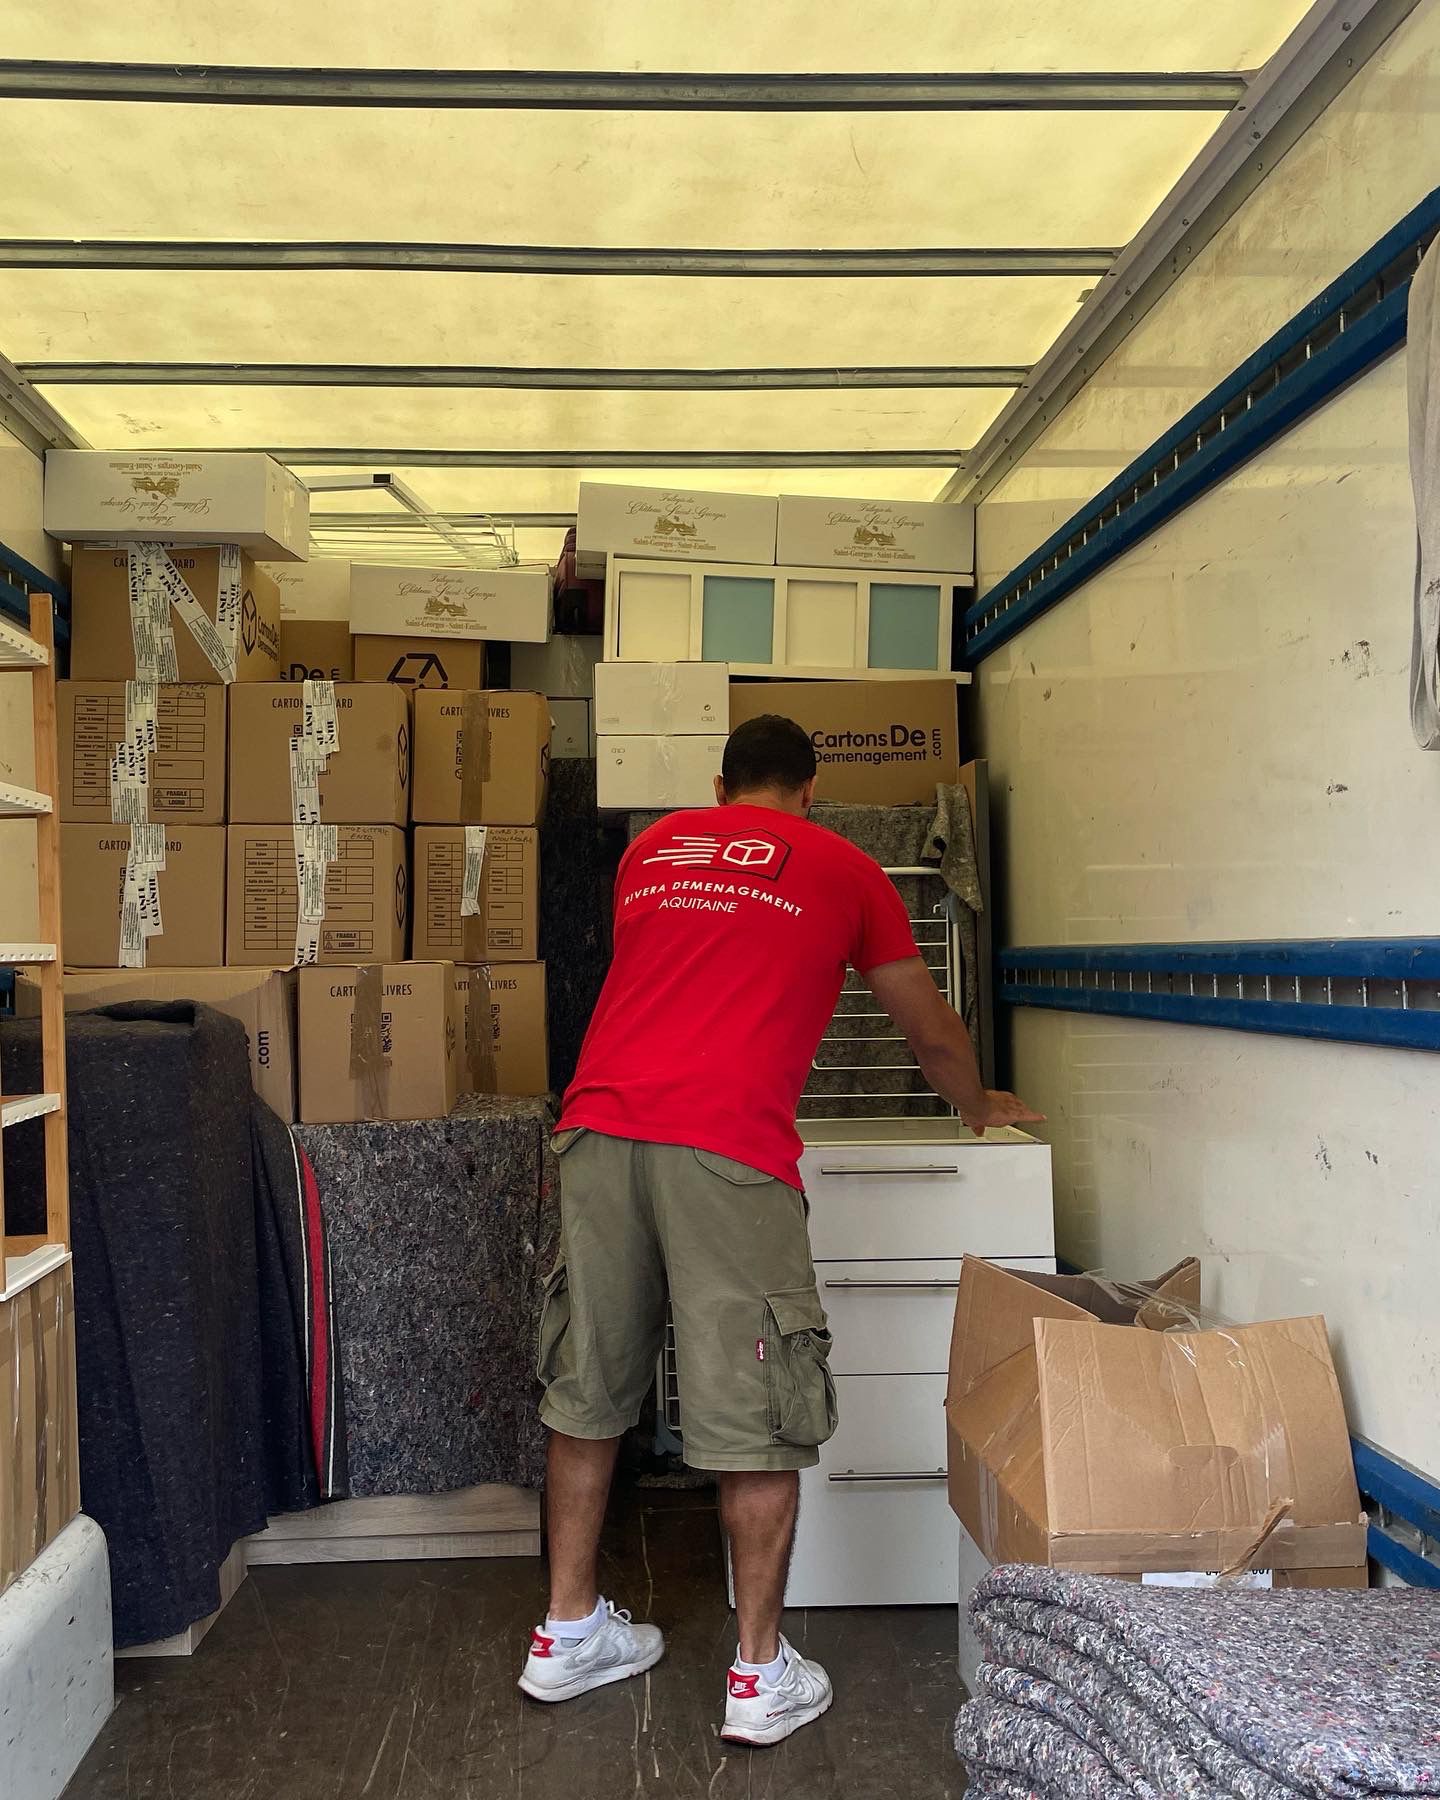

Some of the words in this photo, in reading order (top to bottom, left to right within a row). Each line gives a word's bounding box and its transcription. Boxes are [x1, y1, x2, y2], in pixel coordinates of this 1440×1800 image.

[815, 749, 927, 765] Demenagement
[624, 884, 666, 906] RIVERA
[672, 880, 803, 917] DEMENAGEMENT
[658, 896, 739, 913] AQUITAINE
[490, 980, 517, 991] LIVRES
